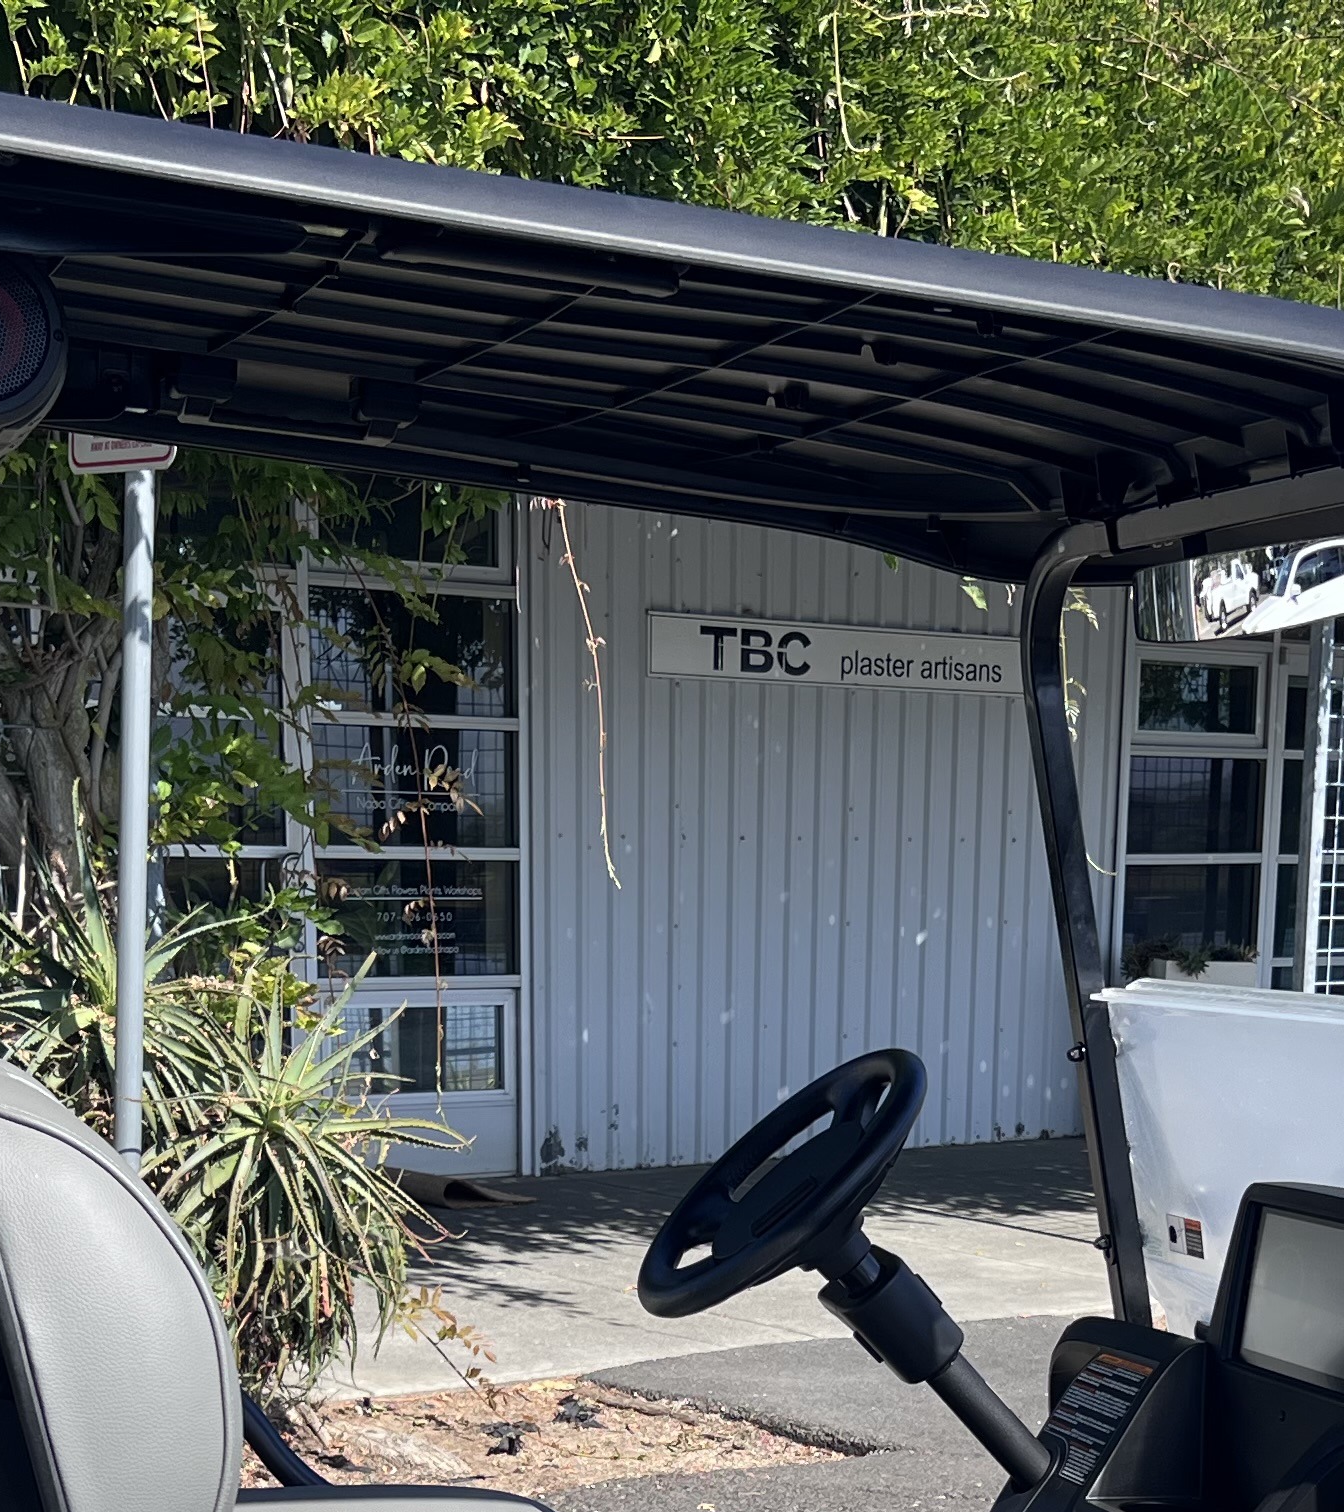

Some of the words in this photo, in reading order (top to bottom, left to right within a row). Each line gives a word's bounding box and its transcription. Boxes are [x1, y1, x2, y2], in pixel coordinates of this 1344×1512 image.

[700, 625, 812, 677] TBC
[840, 651, 914, 682] plaster
[920, 655, 1003, 684] artisans
[352, 743, 419, 786] Arden
